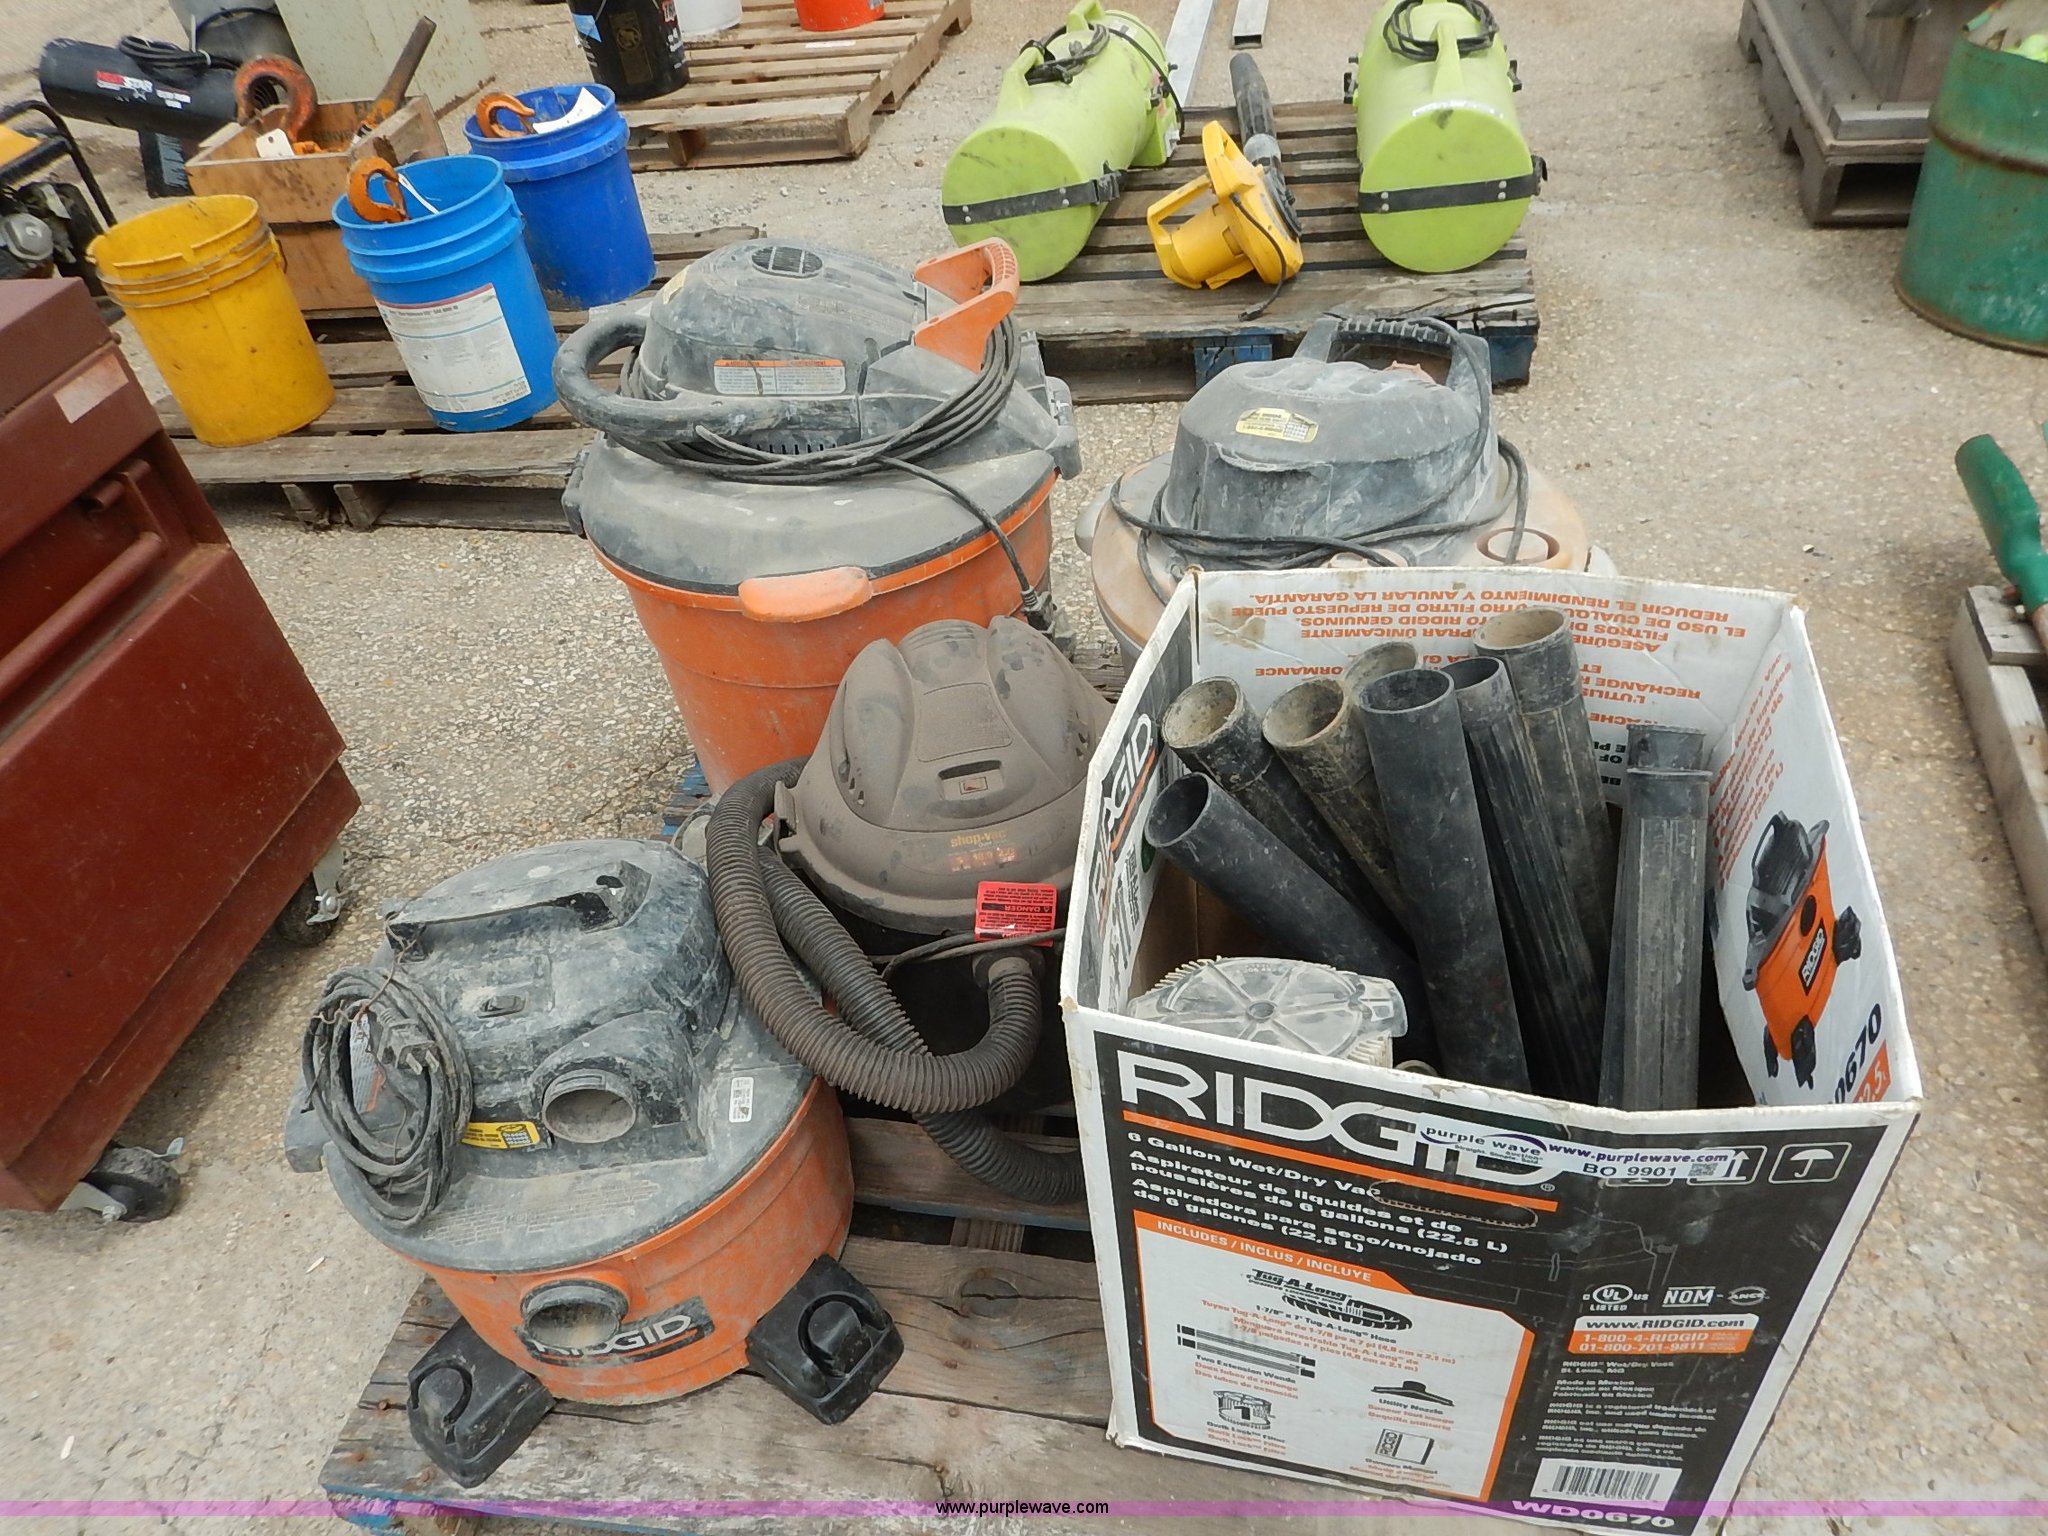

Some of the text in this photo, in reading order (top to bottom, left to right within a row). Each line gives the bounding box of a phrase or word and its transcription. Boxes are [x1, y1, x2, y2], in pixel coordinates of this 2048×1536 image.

[1354, 591, 1378, 601] LA
[1382, 591, 1459, 601] ANULAR
[1462, 591, 1475, 601] Y
[1480, 590, 1610, 608] RENDIMIENTO
[1231, 607, 1288, 617] PUEDE
[1293, 604, 1383, 615] REPUESTO
[1388, 604, 1411, 613] DE
[1416, 604, 1475, 613] FILTRO
[1616, 600, 1636, 611] EL
[1642, 603, 1728, 622] REDUCIR
[1398, 616, 1461, 626] RIDGID
[1563, 608, 1641, 625] CUALQU
[1645, 617, 1671, 629] DE
[1594, 624, 1669, 641] FILTROS
[1677, 621, 1718, 634] USO
[1723, 626, 1746, 638] EL
[1301, 628, 1660, 653] ASEGÚRE PRAR ÚNICAMENTE
[1580, 664, 1601, 674] ET
[1256, 666, 1701, 699] RECHANGE ORMANCE
[1581, 688, 1646, 704] L'UTILIS
[1834, 1003, 1882, 1104] 0670
[1426, 1127, 1541, 1156] purple wave
[1549, 1143, 1728, 1163] www.purplewave.com
[1127, 1132, 1381, 1197] 6 Gallon Wet/Dry Vac
[1583, 1163, 1676, 1177] BO 9901
[1129, 1151, 1462, 1233] Aspirateur de liquides et de
[1131, 1162, 1257, 1199] poussières
[1264, 1194, 1293, 1207] de
[1299, 1202, 1314, 1213] 6
[1320, 1210, 1409, 1234] gallons
[1486, 1240, 1508, 1253] L)
[1132, 1178, 1481, 1265] Aspiradora para seco/mojado
[1134, 1189, 1160, 1201] de
[1166, 1197, 1179, 1207] 6
[1185, 1202, 1274, 1230] galones
[1344, 1241, 1364, 1253] L)
[1157, 1220, 1228, 1246] INCLUDES
[1240, 1242, 1294, 1263] INCLUS
[1306, 1259, 1372, 1282] INCLUYE
[1602, 1288, 1622, 1301] UL
[1663, 1289, 1716, 1305] NOM
[1586, 1318, 1744, 1329] www.RIDGID.com
[1583, 1332, 1709, 1343] 1-800-4-RIDGID
[1579, 1341, 1705, 1352] 01-800-701-9811
[1512, 1500, 1675, 1528] WD0670
